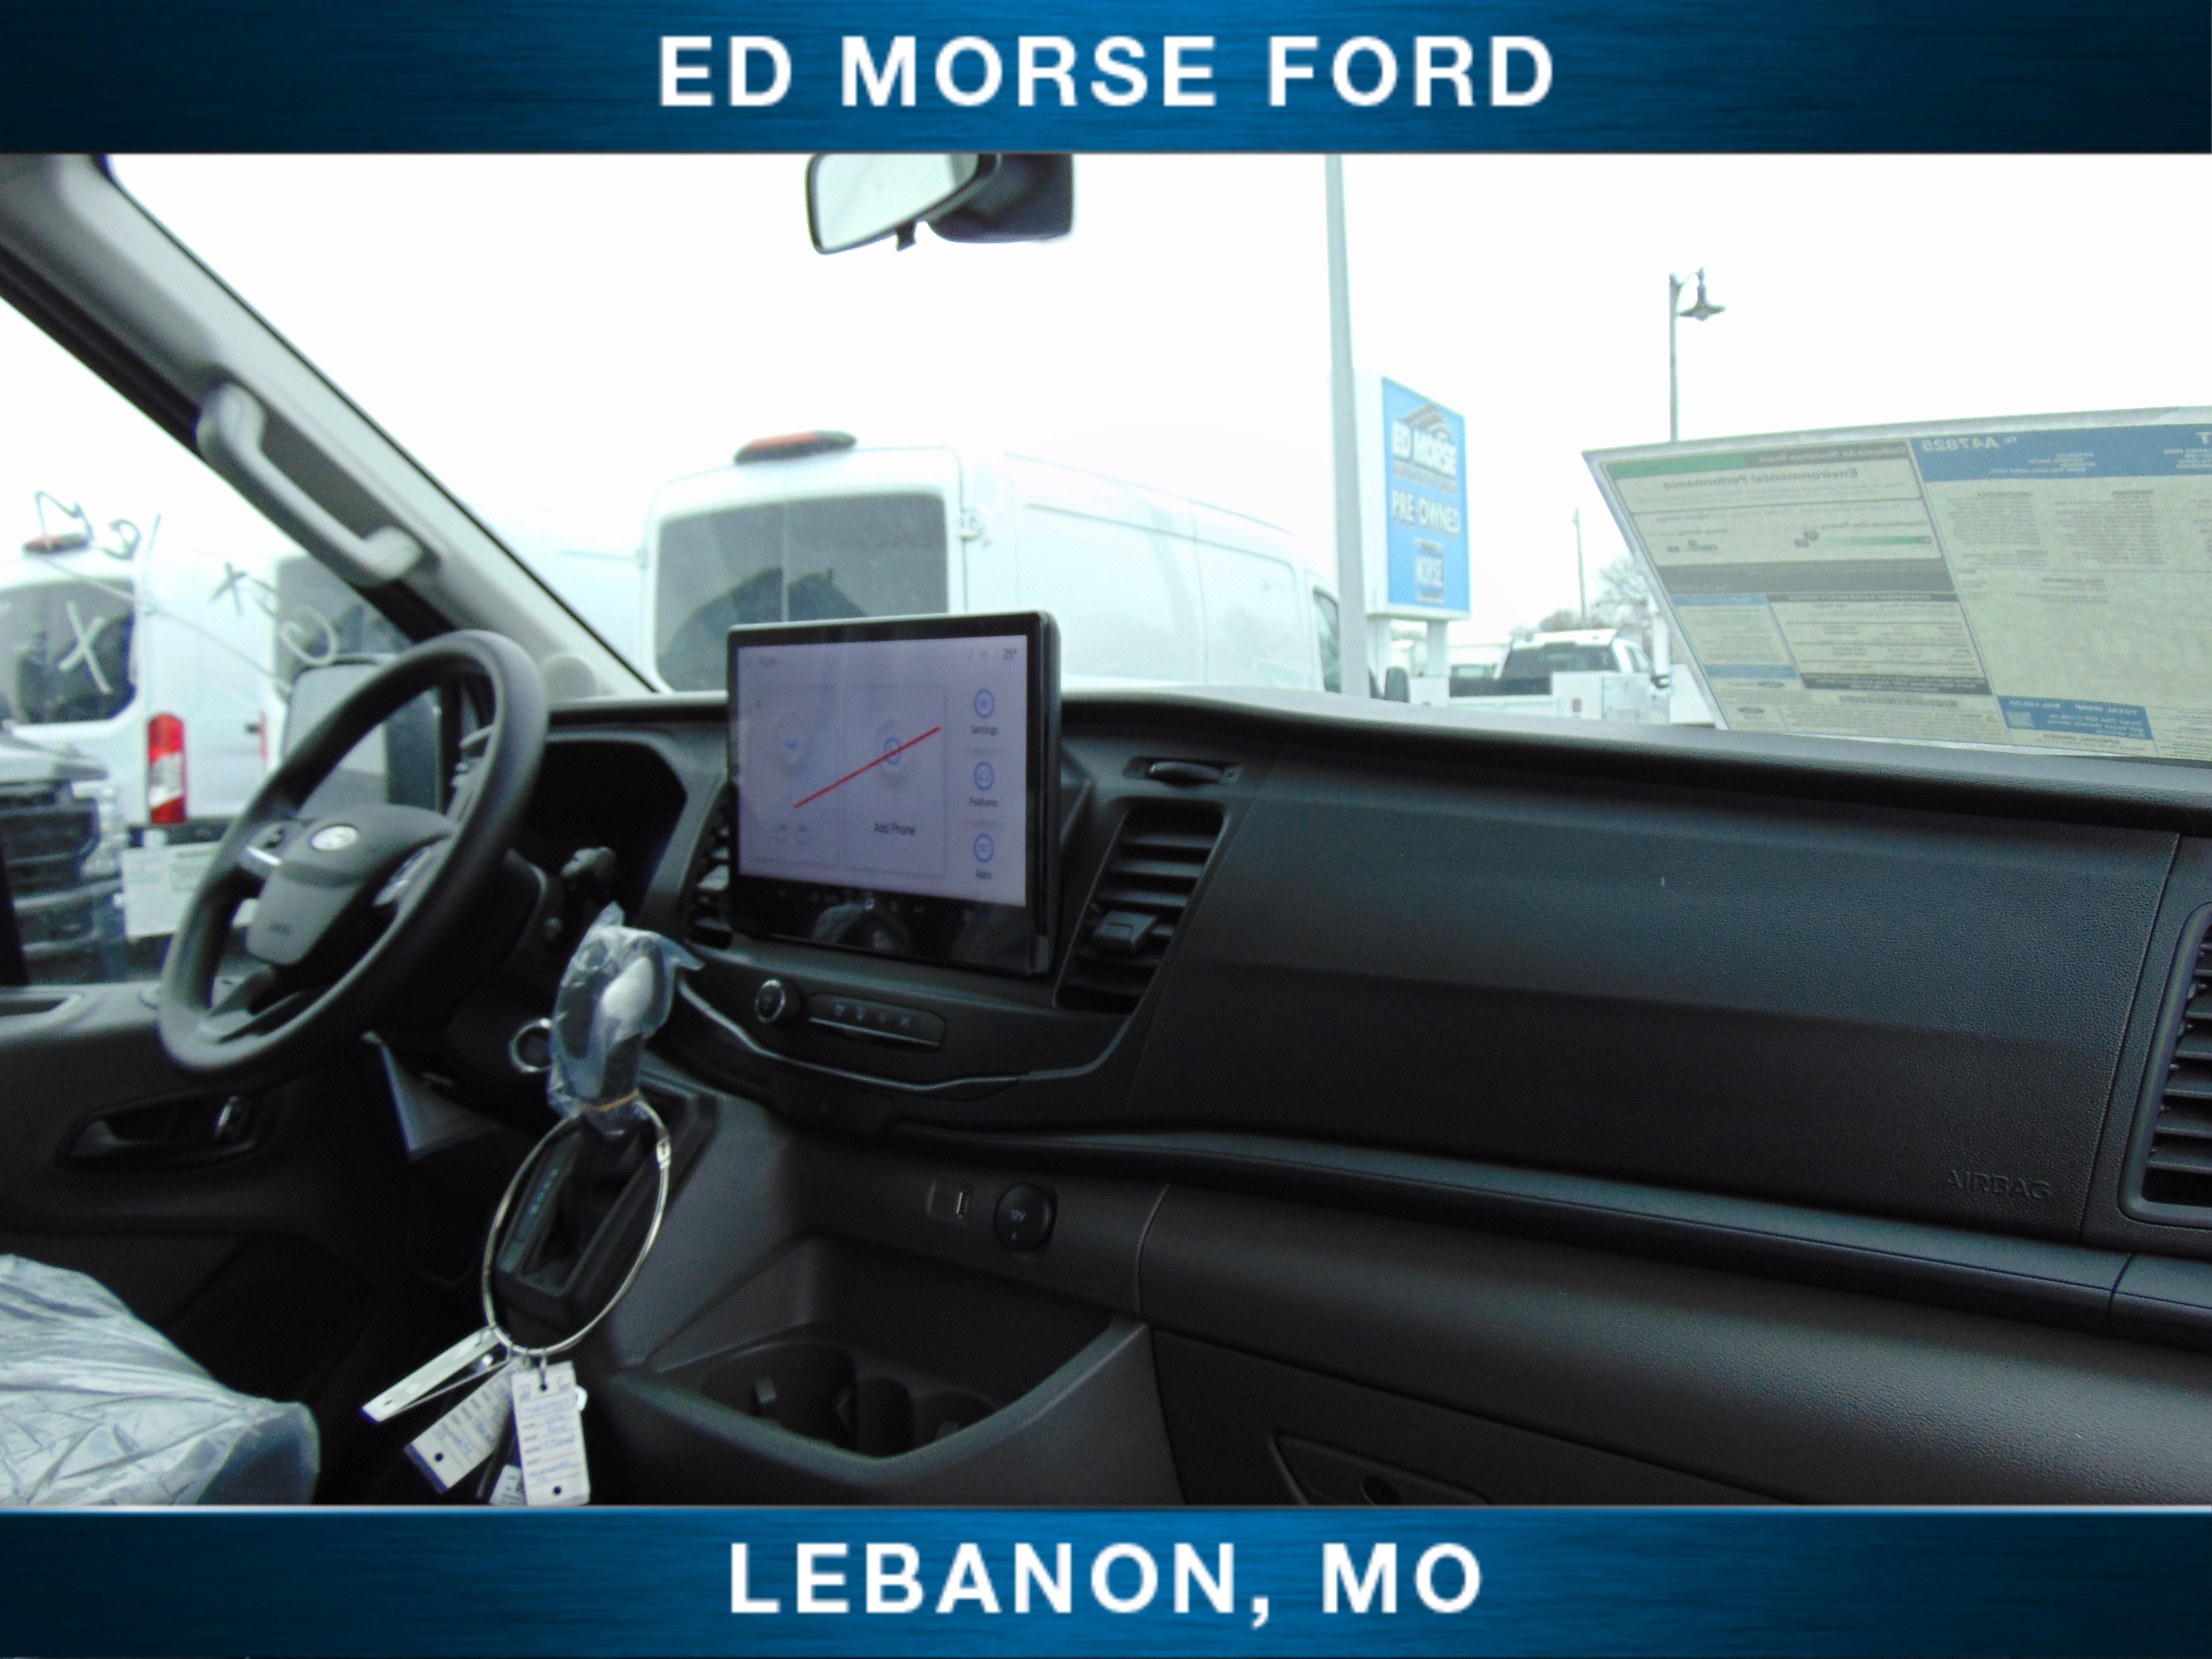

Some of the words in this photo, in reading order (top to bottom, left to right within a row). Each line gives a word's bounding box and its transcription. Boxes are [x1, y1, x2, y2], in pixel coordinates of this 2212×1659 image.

[1392, 419, 1411, 459] ED
[1392, 487, 1459, 537] PRE-OWNED
[1948, 1170, 2052, 1200] AIRBAG
